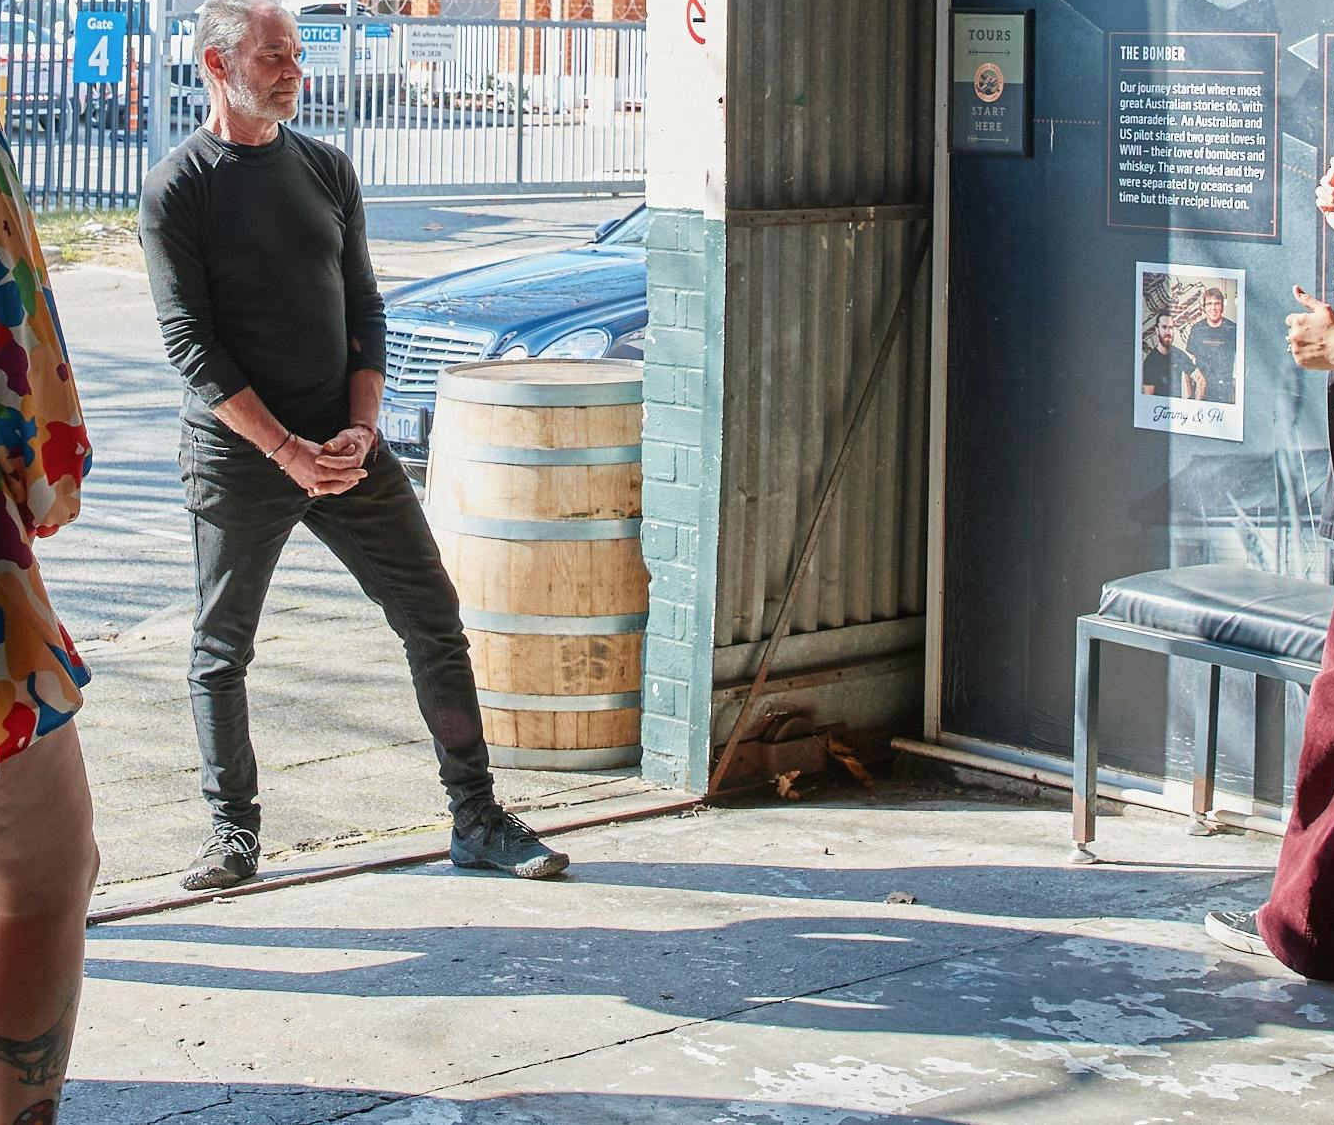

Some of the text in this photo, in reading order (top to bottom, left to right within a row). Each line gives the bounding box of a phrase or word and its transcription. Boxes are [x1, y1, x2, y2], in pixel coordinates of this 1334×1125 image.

[87, 17, 114, 30] Gate
[968, 29, 1011, 41] TOURS
[88, 35, 109, 76] 4
[1120, 45, 1186, 62] THE BOMBER
[1120, 81, 1262, 98] Our journey started where most
[972, 107, 1006, 116] START
[975, 121, 1002, 131] HERE
[1180, 114, 1194, 127] An
[1194, 114, 1244, 129] Australian
[1244, 116, 1263, 129] and
[1157, 161, 1176, 174] The
[1176, 164, 1195, 175] war
[1194, 163, 1224, 177] ended
[1223, 164, 1243, 178] and
[1243, 165, 1266, 181] they
[1119, 191, 1140, 204] time
[1140, 192, 1157, 205] but
[1157, 193, 1180, 206] their
[1180, 194, 1210, 210] recipe
[1210, 195, 1234, 210] lived
[1153, 405, 1188, 425] Jimmy
